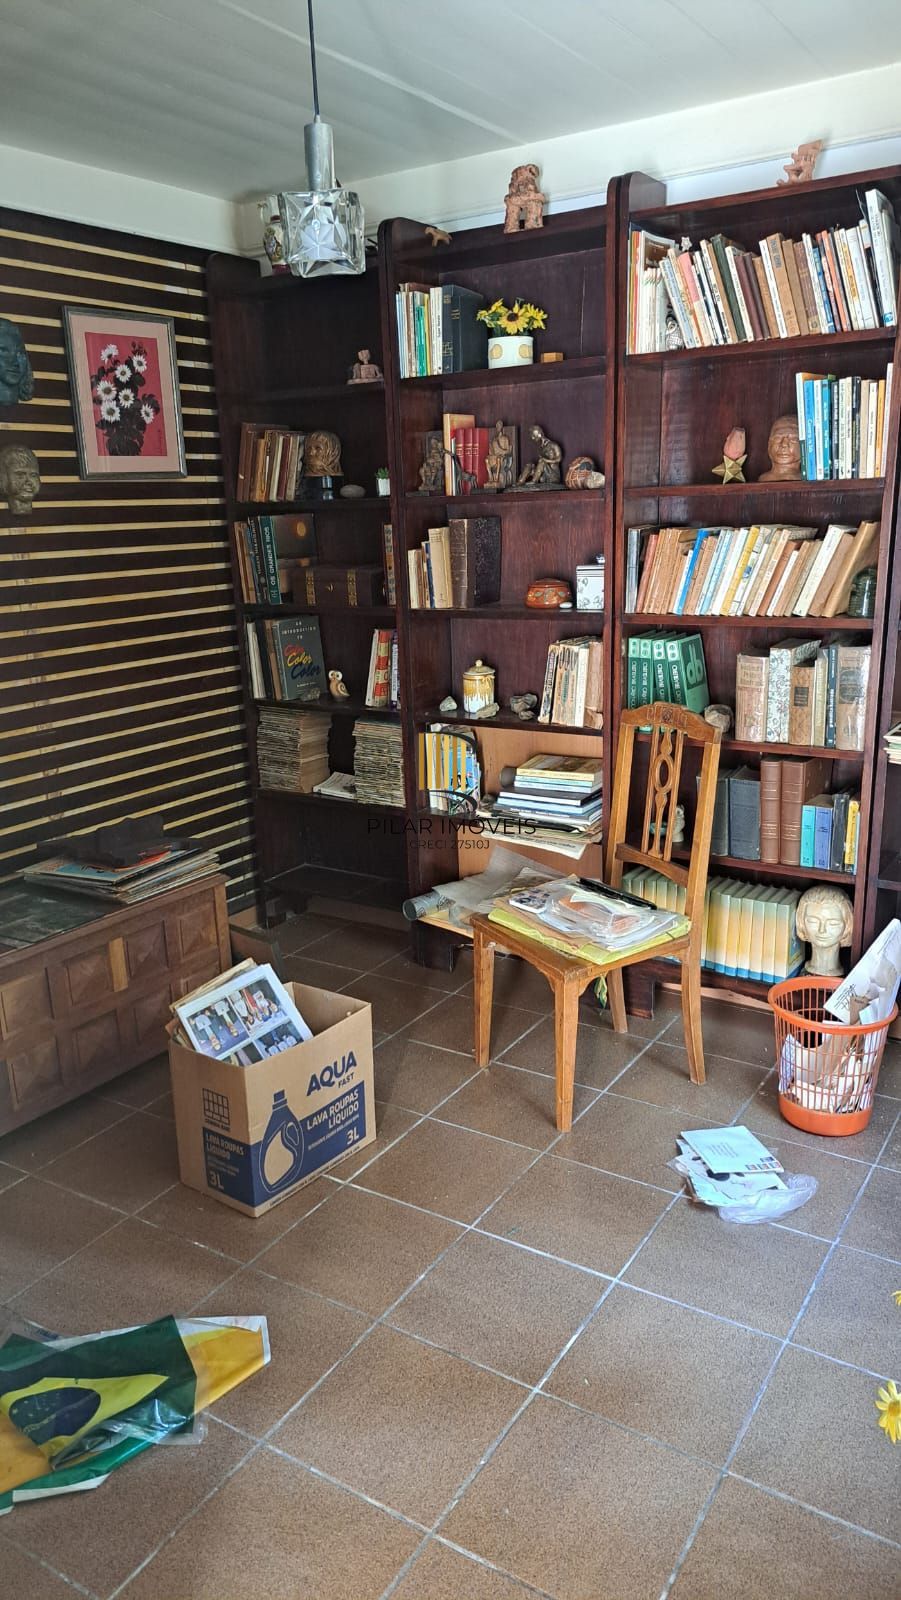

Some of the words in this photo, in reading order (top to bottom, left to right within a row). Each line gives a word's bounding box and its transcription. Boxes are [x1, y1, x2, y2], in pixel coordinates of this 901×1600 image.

[306, 1051, 357, 1096] AQUA
[338, 1072, 354, 1088] FAST
[306, 1110, 328, 1130] LAVA
[329, 1089, 359, 1116] ROUPAS
[346, 1126, 360, 1145] 3L
[209, 1170, 225, 1190] 3L
